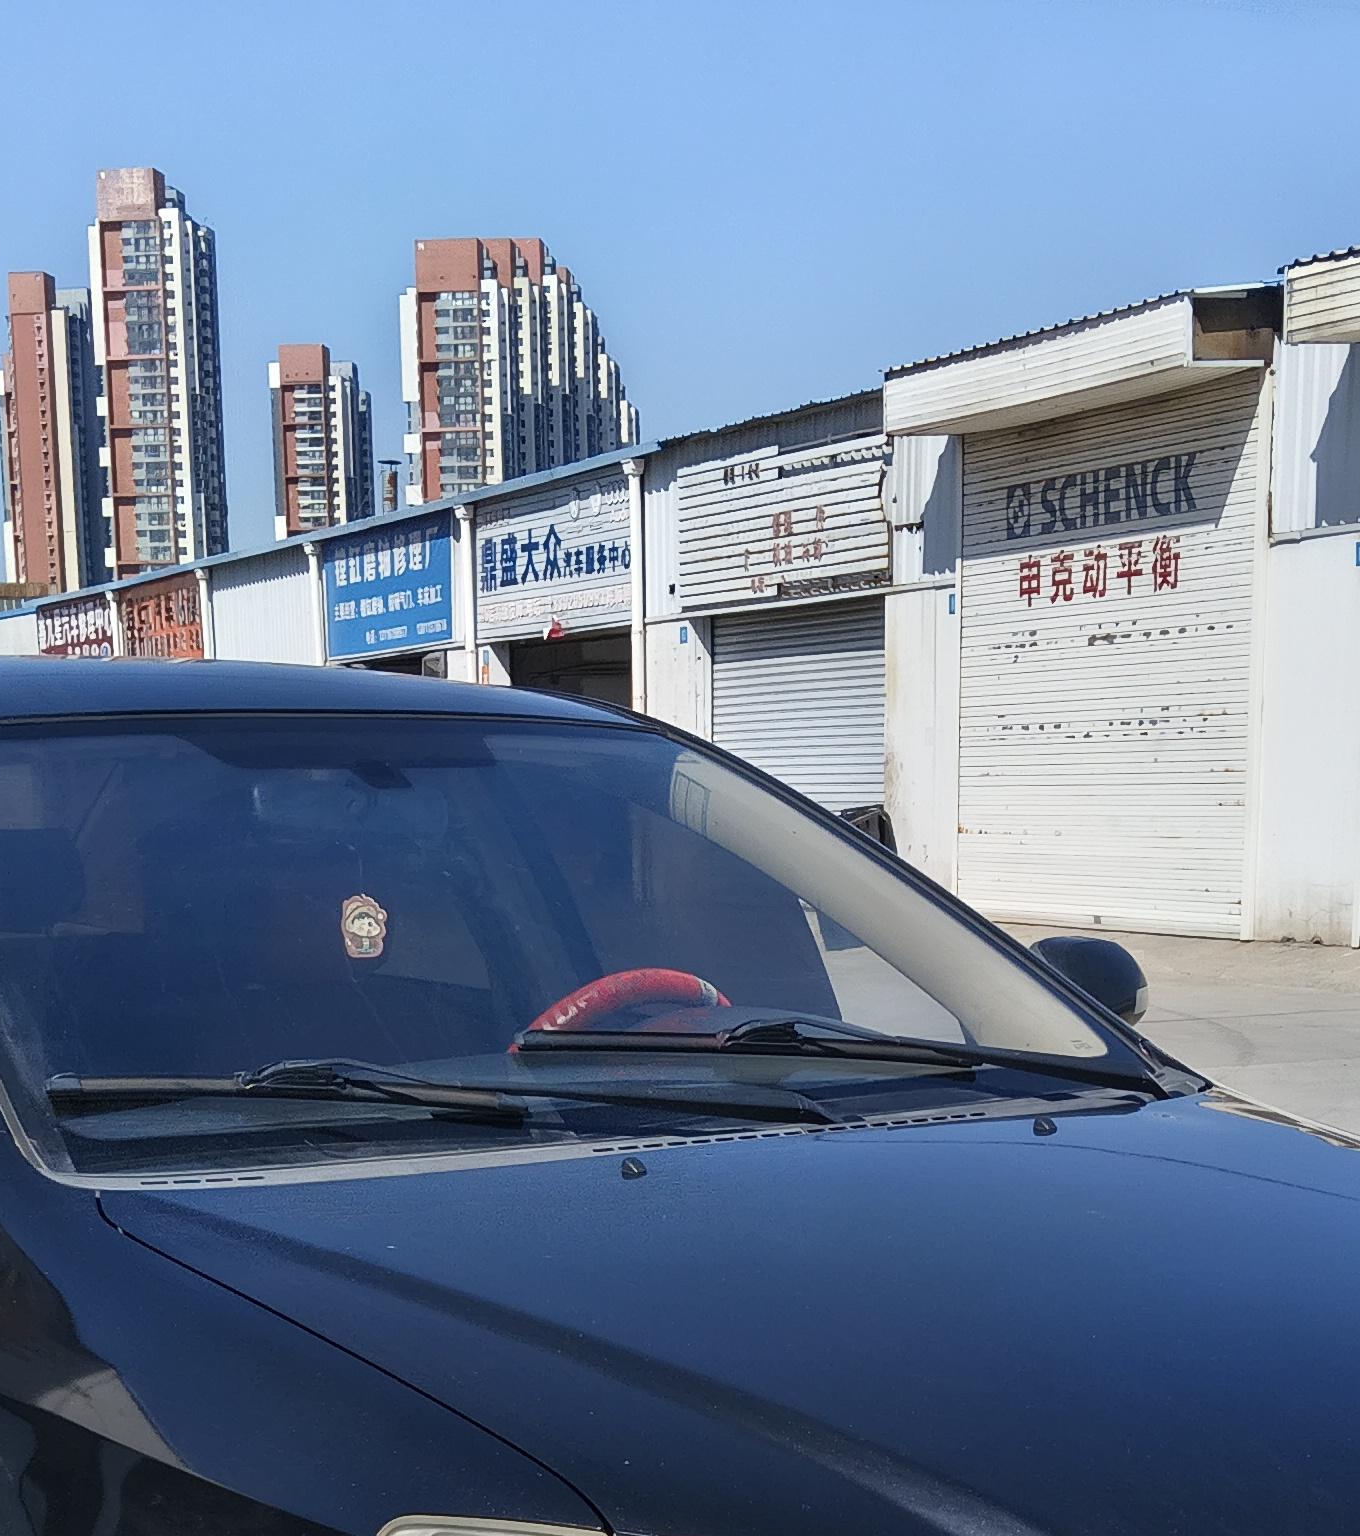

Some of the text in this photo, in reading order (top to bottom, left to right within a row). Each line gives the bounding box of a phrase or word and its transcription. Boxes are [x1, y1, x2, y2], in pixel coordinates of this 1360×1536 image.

[1040, 452, 1199, 534] SCHENCK
[480, 523, 631, 594] 鼎盛大众 汽车服务中心
[1019, 535, 1181, 607] 申克动平衡
